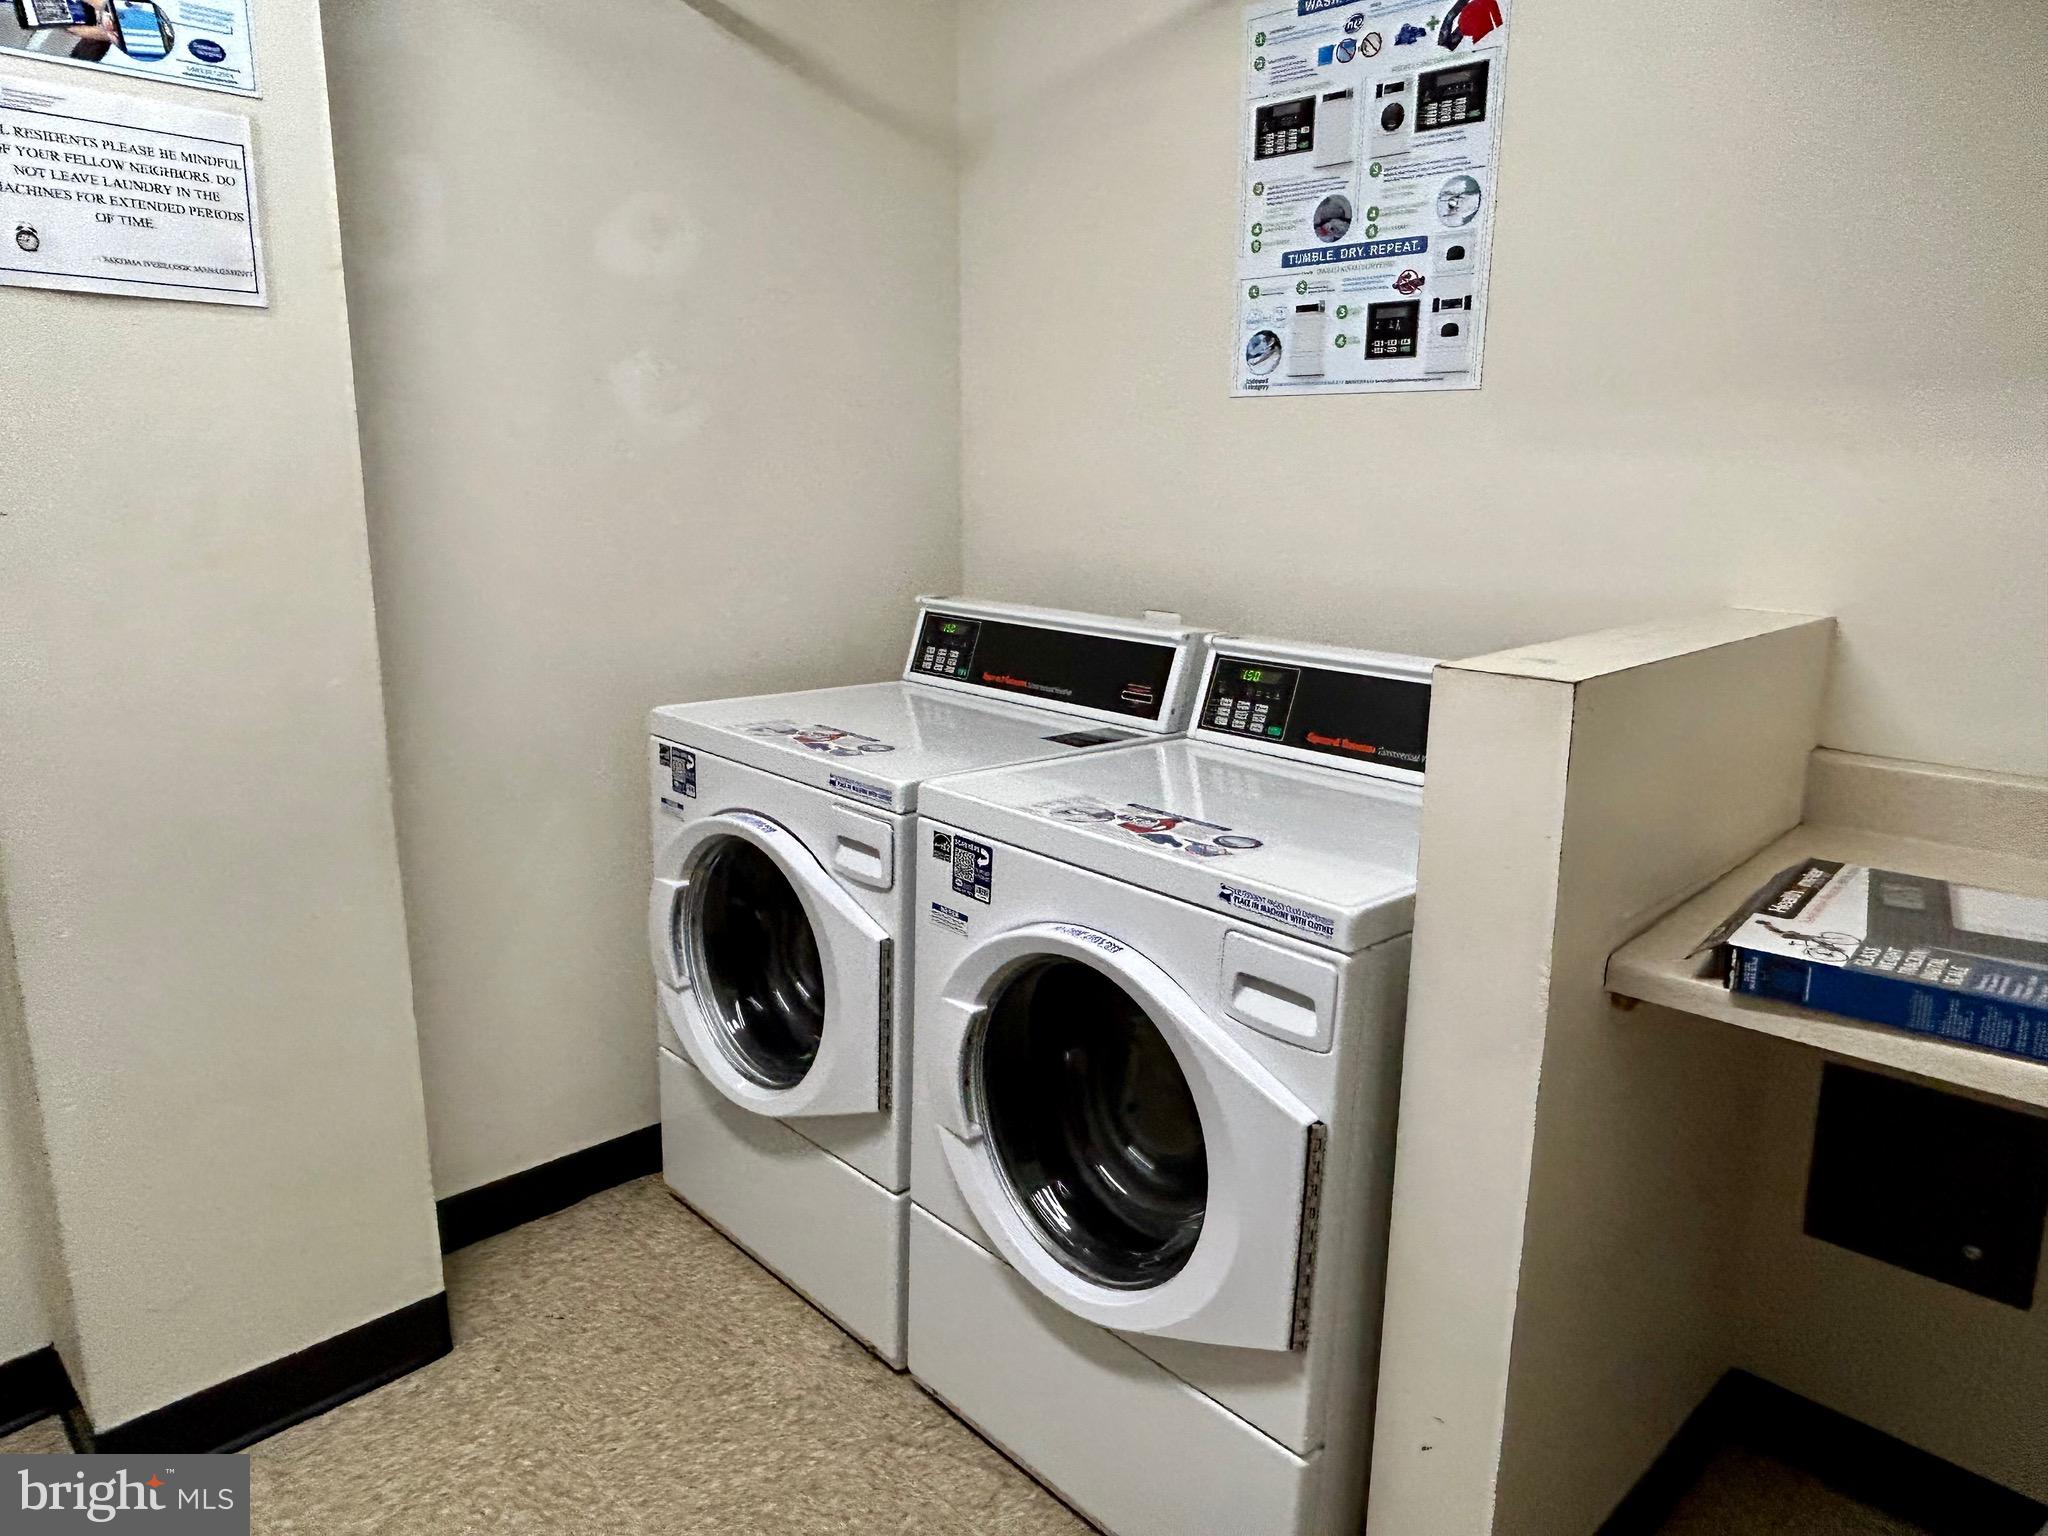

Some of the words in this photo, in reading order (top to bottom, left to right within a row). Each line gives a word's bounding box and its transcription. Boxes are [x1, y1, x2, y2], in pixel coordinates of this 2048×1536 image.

[13, 126, 99, 149] RESIDENTS
[101, 140, 155, 157] PLEASE
[159, 148, 176, 161] BE
[181, 151, 242, 171] MINDFUL
[15, 145, 61, 162] YOUR
[63, 153, 124, 170] FELLOW
[129, 162, 214, 183] NEIGHBORS.
[217, 175, 236, 187] DO
[13, 164, 46, 178] NOT
[50, 169, 100, 186] LEAVE
[102, 176, 172, 195] LAUNDRY
[177, 186, 191, 198] IN
[193, 189, 221, 202] THE
[76, 192, 107, 205] FOR
[109, 196, 186, 214] EXTENDED
[189, 206, 245, 222] PERIODS
[95, 212, 113, 224] OF
[1288, 250, 1337, 265] TUMBLE.
[1340, 246, 1367, 259] DRY.
[1368, 240, 1422, 256] REPEAT.
[1260, 904, 1289, 921] MACHINE
[1289, 914, 1307, 927] WITH
[1307, 920, 1334, 936] CLOTHES
